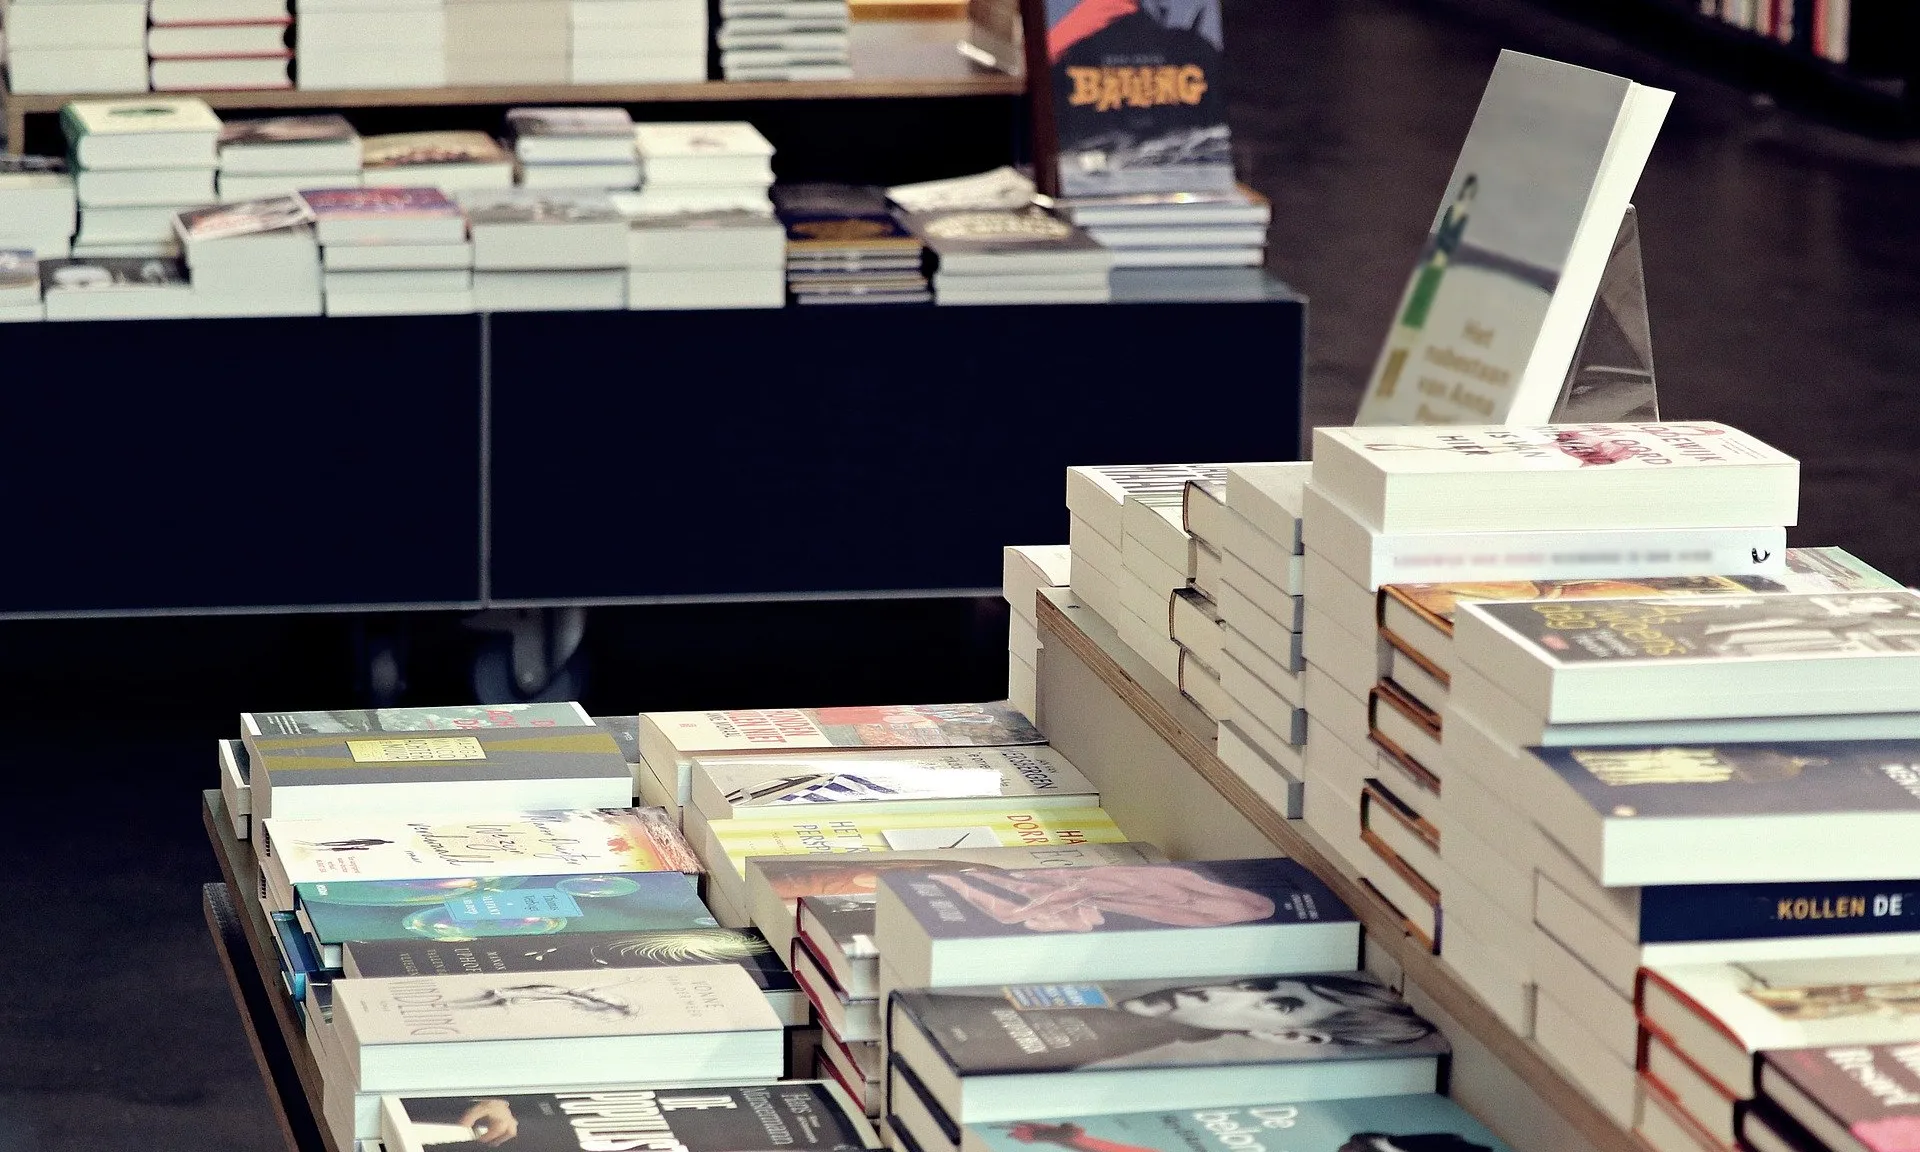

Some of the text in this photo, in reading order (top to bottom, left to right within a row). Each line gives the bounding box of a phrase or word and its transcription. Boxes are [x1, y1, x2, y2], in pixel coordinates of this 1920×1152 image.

[1435, 435, 1492, 455] HIER
[1500, 441, 1547, 457] VAN
[1611, 439, 1673, 464] OORD
[740, 728, 787, 743] NIET
[465, 823, 527, 855] We zijn
[828, 821, 860, 839] HET
[407, 823, 494, 865] verdwaald
[1776, 893, 1903, 921] KOLLEN DE
[690, 981, 724, 1008] VONNE
[388, 979, 459, 1035] VINDELING
[656, 1096, 738, 1111] DE
[781, 1094, 813, 1113] Hans
[1249, 1107, 1298, 1128] De
